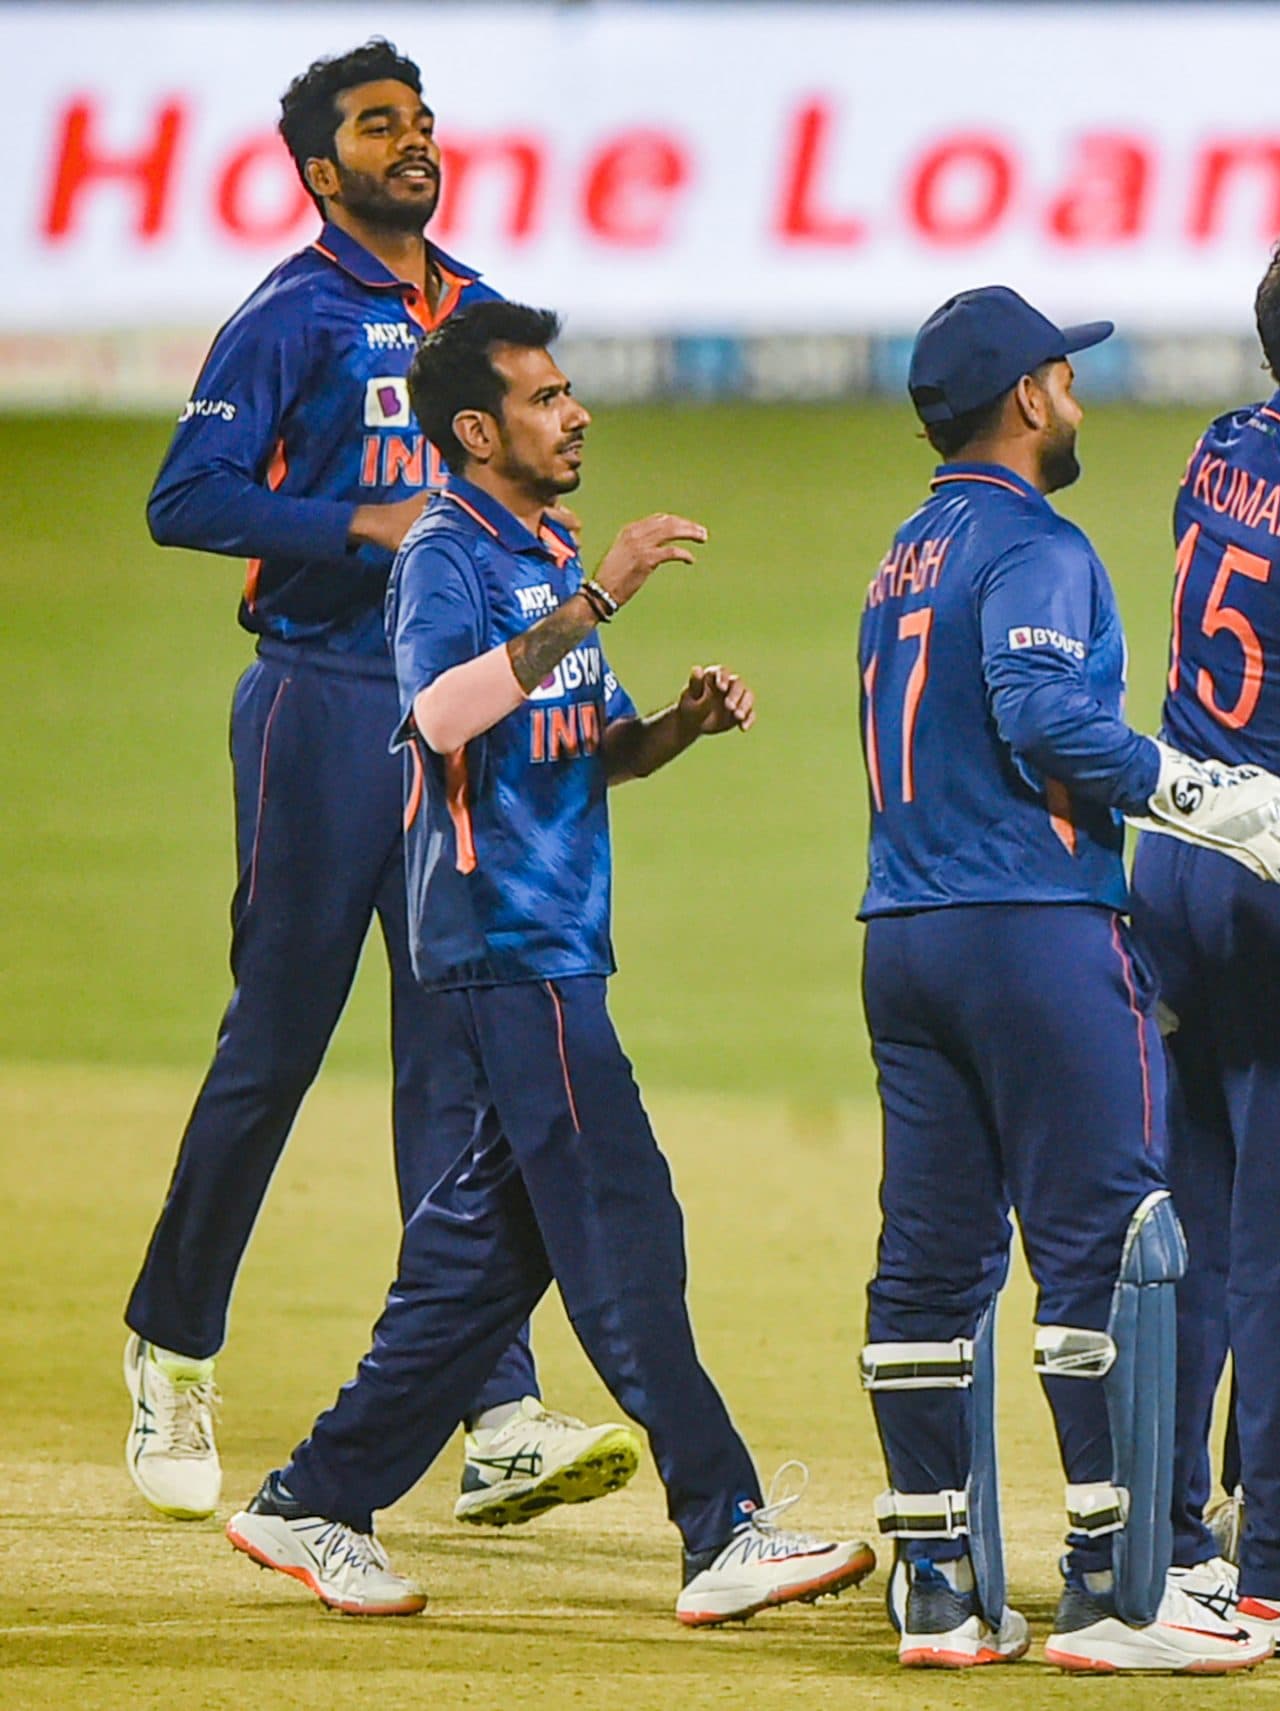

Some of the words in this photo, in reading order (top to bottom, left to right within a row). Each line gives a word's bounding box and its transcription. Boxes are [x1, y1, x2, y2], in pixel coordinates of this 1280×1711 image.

[514, 583, 559, 610] MPL
[1167, 522, 1272, 730] 15
[862, 606, 934, 814] 17
